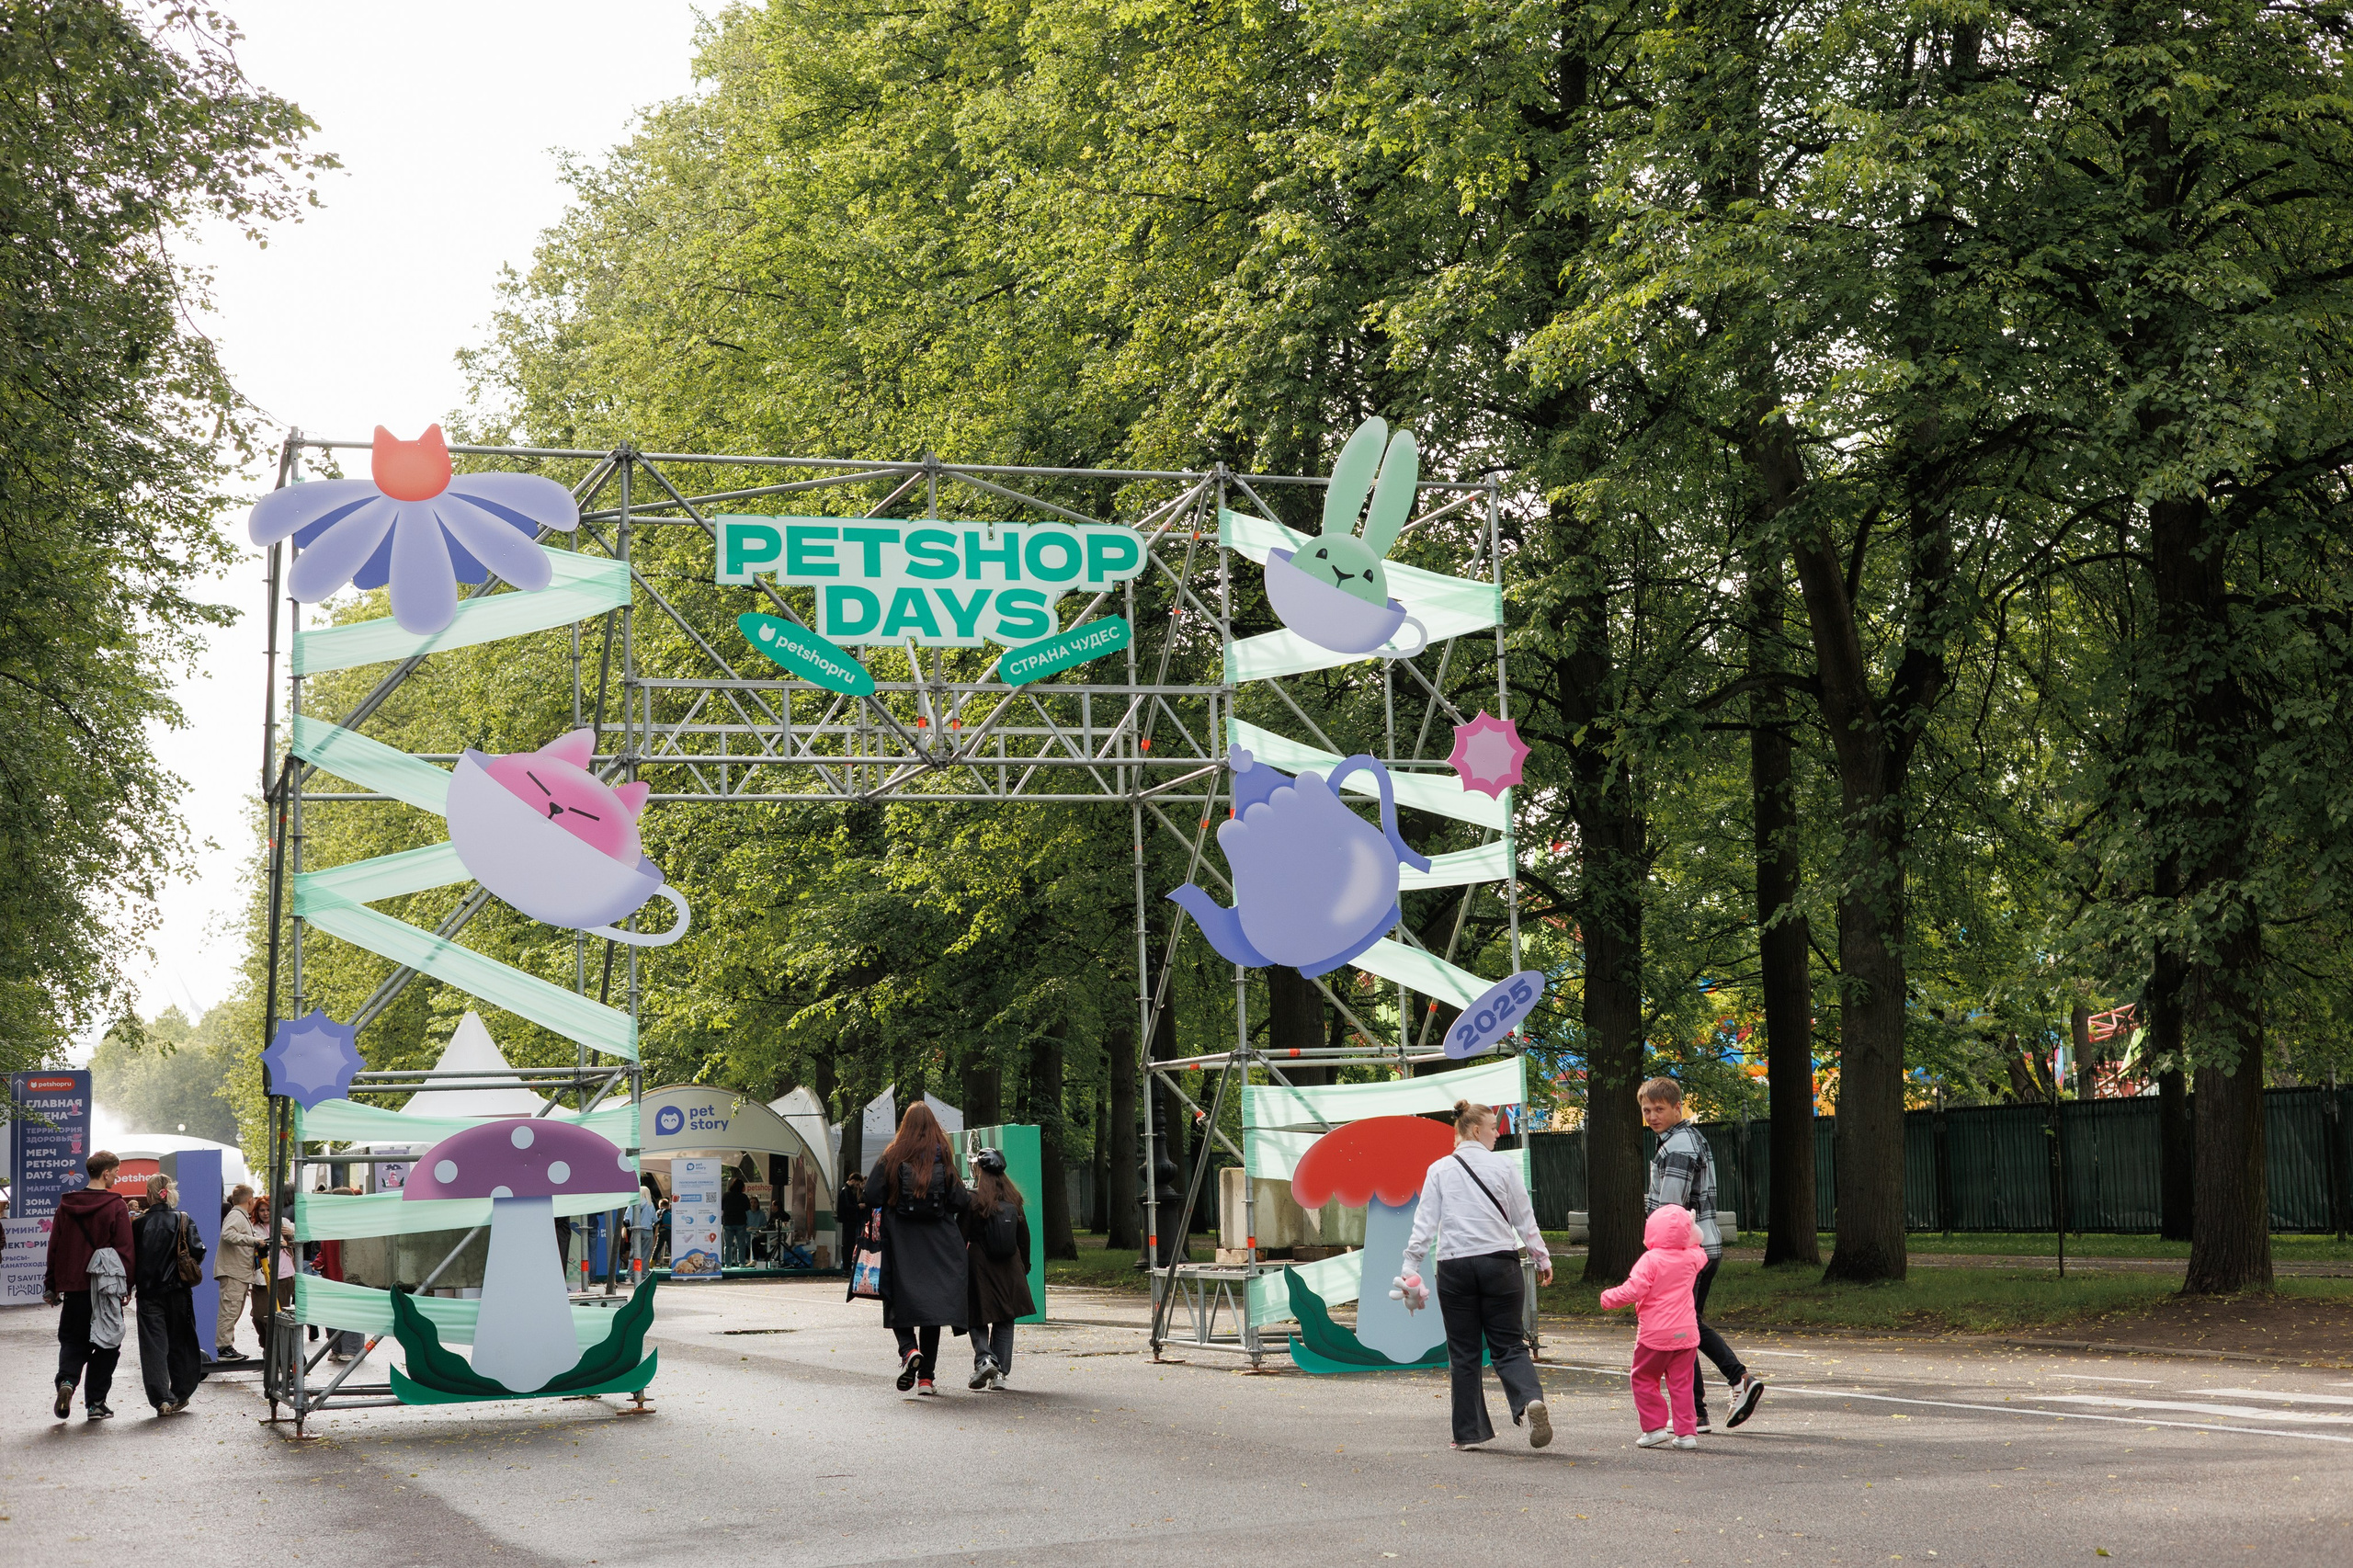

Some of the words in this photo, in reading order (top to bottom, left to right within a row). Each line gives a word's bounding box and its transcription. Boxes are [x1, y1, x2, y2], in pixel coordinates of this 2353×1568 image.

[725, 524, 1140, 583] PETSHOP
[825, 584, 1051, 640] DAYS
[1009, 645, 1070, 675] СТРАНА
[1070, 626, 1120, 652] ЧУДЕС
[775, 635, 856, 685] petshopru
[1456, 978, 1533, 1051] 2025
[26, 1098, 83, 1108] ГЛАВНАЯ
[689, 1104, 715, 1119] pet
[26, 1126, 83, 1134] ТЕРРИТОРИЯ
[690, 1118, 729, 1131] story
[26, 1148, 57, 1157] МЕРЧ
[26, 1159, 76, 1168] PETSHOP
[26, 1171, 53, 1180] DAYS
[4, 1226, 40, 1235] УМИНГ
